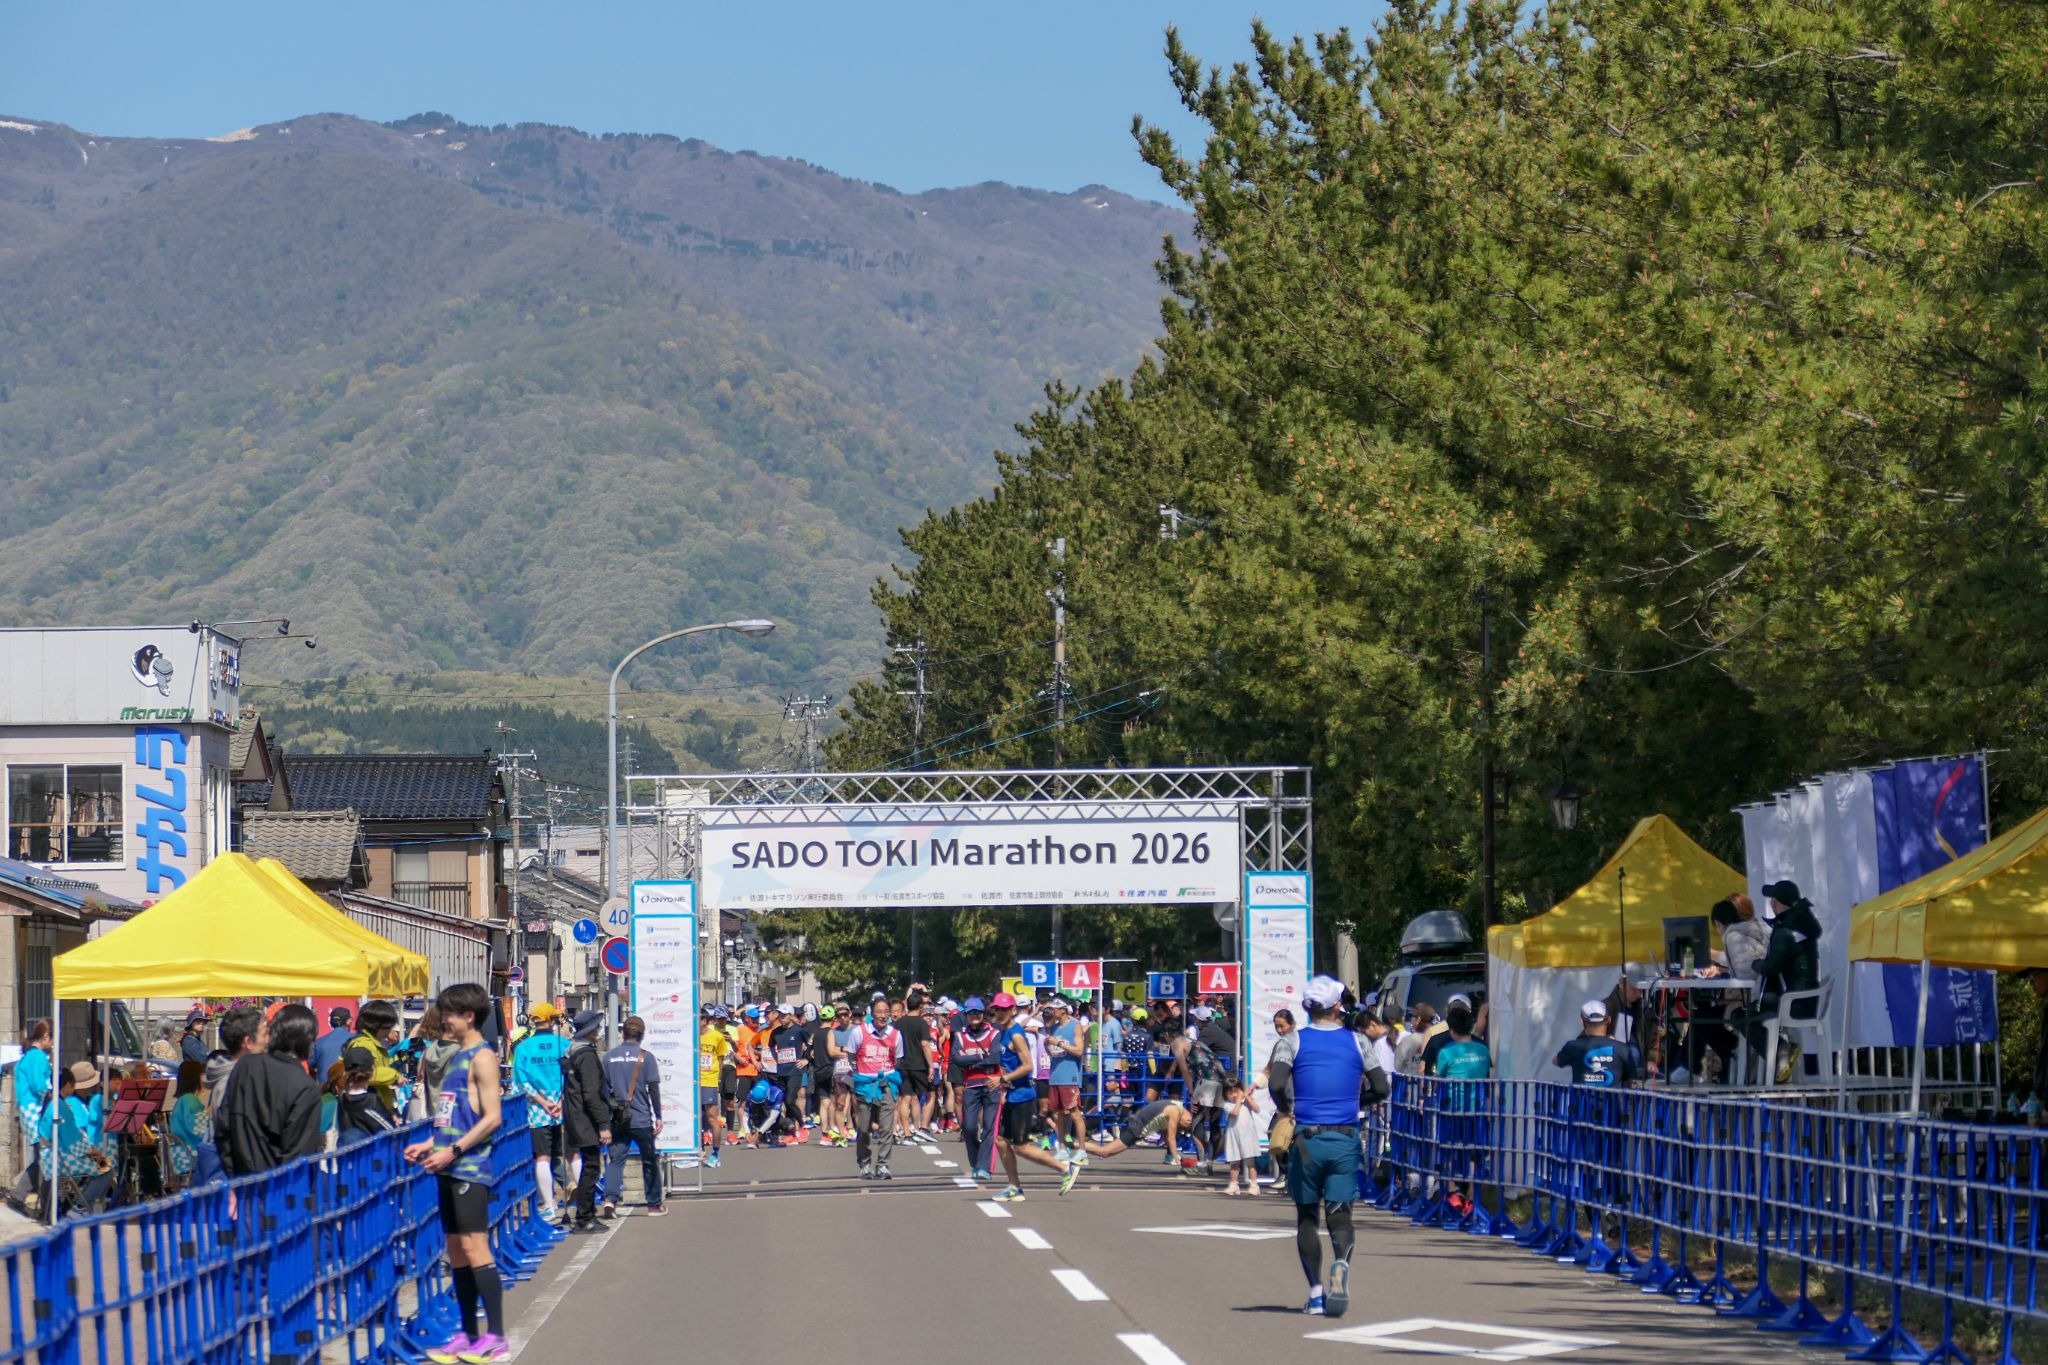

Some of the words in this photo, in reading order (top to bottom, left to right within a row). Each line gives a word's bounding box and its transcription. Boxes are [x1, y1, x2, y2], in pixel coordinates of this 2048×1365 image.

[732, 841, 828, 869] SADO
[835, 839, 918, 868] TOKI
[931, 835, 1117, 867] Marathon
[1131, 832, 1210, 865] 2026
[608, 909, 629, 925] 40
[1032, 964, 1048, 984] B
[1072, 964, 1091, 985] A
[1209, 967, 1229, 989] A
[1013, 981, 1023, 996] C
[1123, 985, 1136, 1001] C
[1160, 975, 1175, 995] B
